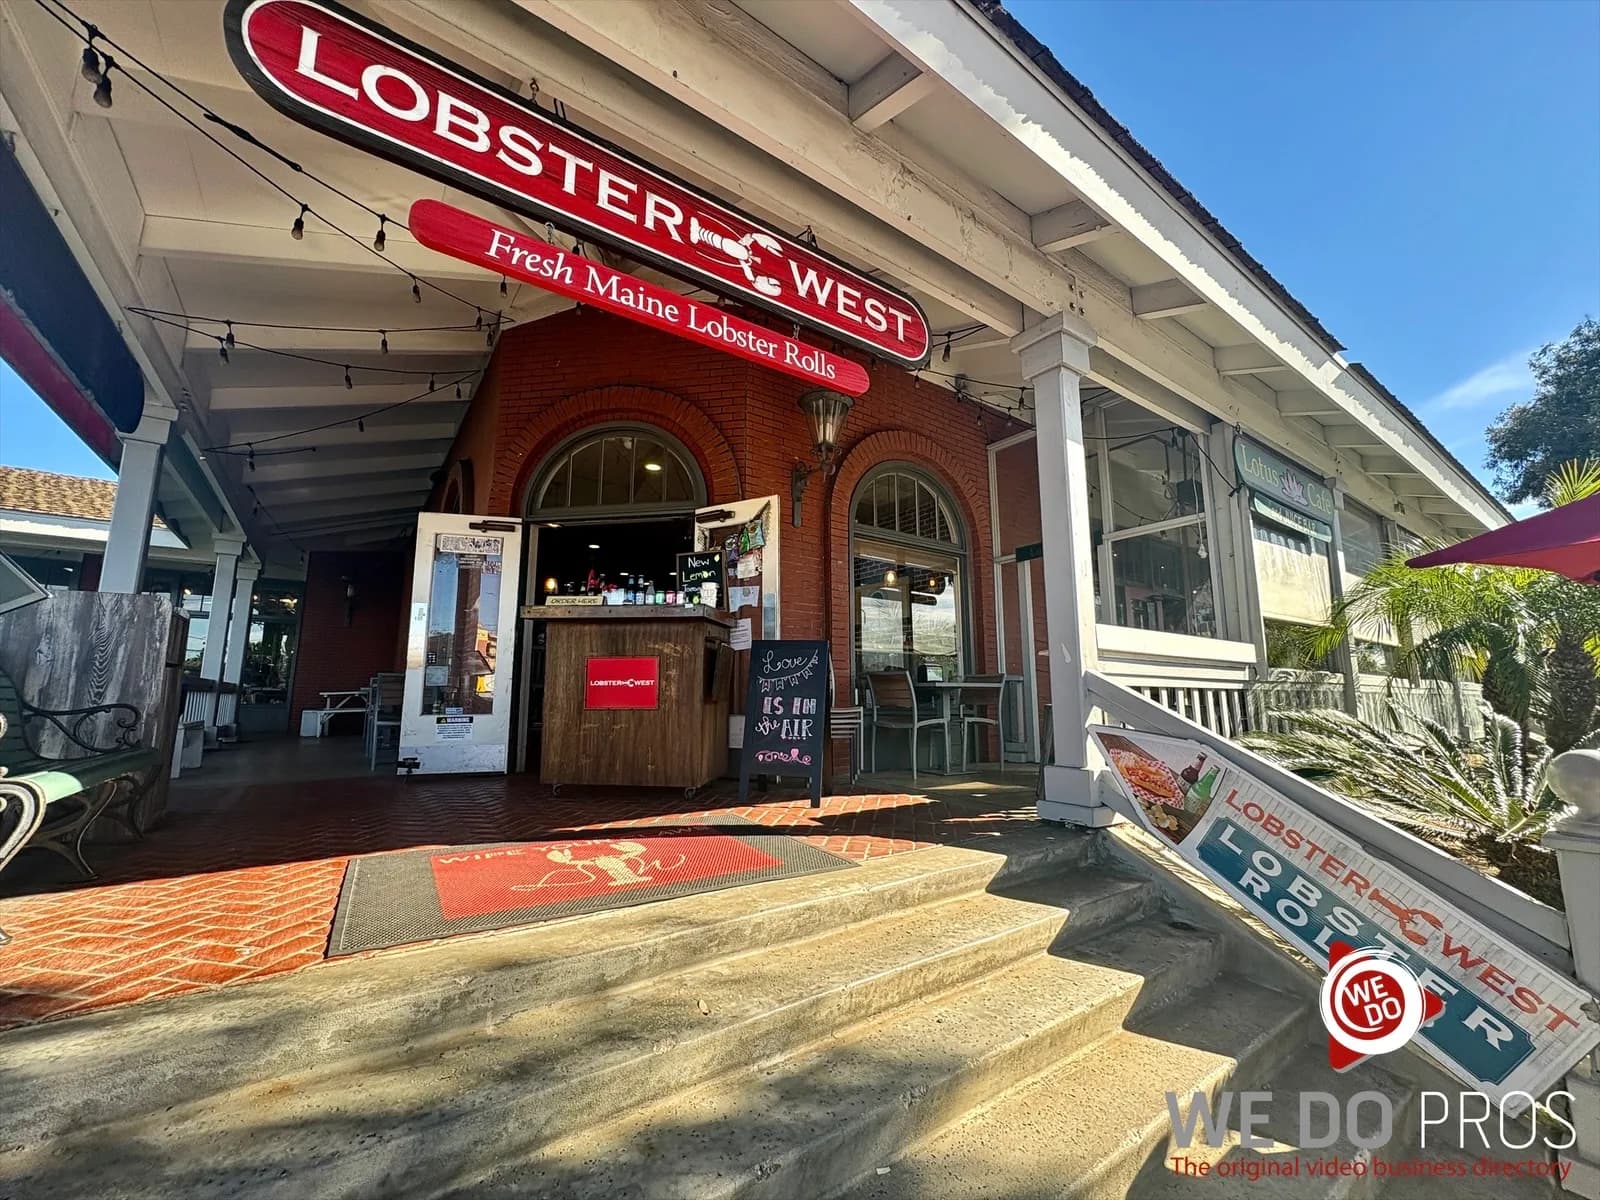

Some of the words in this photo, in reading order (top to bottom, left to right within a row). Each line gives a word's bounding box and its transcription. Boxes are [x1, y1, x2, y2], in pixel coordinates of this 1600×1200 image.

[295, 26, 684, 242] LOBSTER
[788, 259, 914, 343] WEST
[484, 228, 574, 286] Fresh
[583, 264, 680, 322] Maine
[687, 303, 778, 359] Lobster
[784, 340, 836, 379] Rolls
[1240, 443, 1280, 488] Lotus
[688, 556, 710, 568] New
[682, 570, 717, 583] Lemon
[762, 650, 808, 674] Love
[762, 696, 784, 715] IS
[755, 715, 781, 736] the
[780, 718, 814, 738] AIR
[1224, 788, 1371, 898] LOBSTER
[1440, 933, 1579, 1034] WEST
